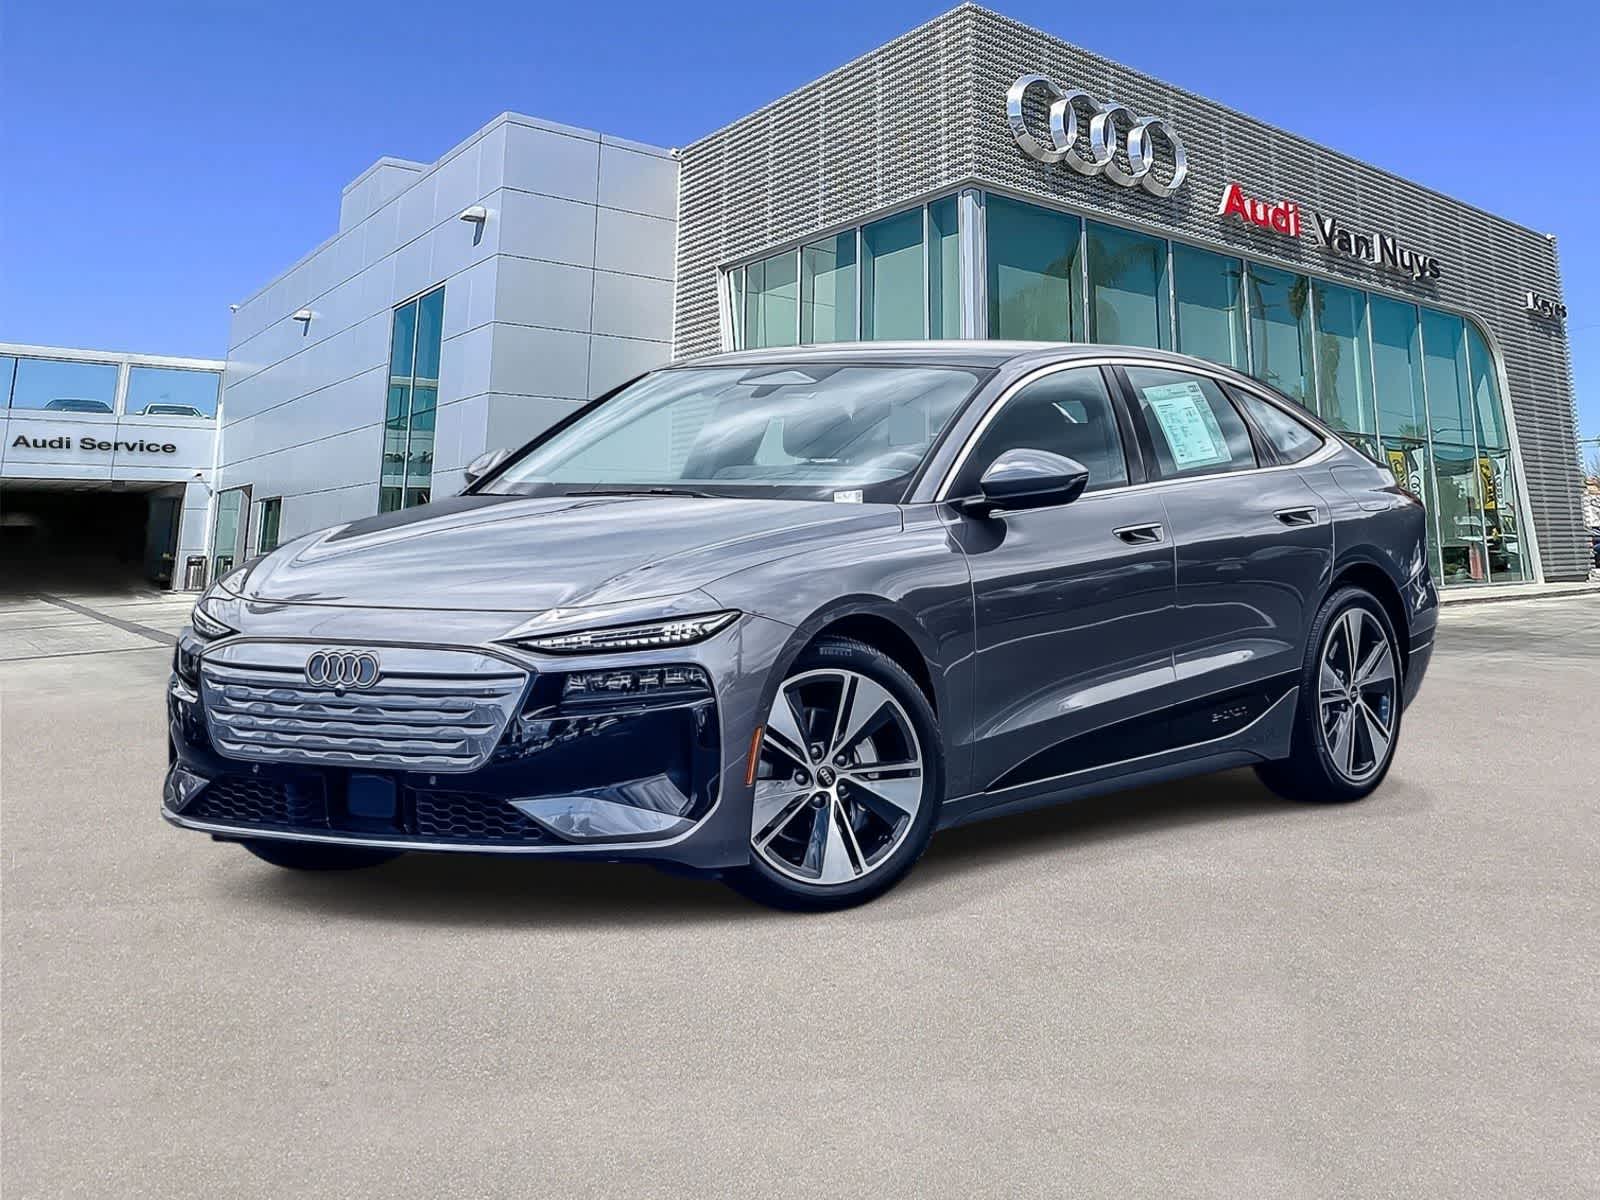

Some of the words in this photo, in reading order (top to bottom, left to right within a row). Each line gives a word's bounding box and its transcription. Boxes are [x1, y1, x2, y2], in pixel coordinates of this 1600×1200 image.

[1219, 183, 1302, 238] Audi
[1312, 213, 1370, 259] Van
[1373, 232, 1441, 281] Nuys
[12, 435, 71, 449] Audi
[79, 437, 177, 454] Service
